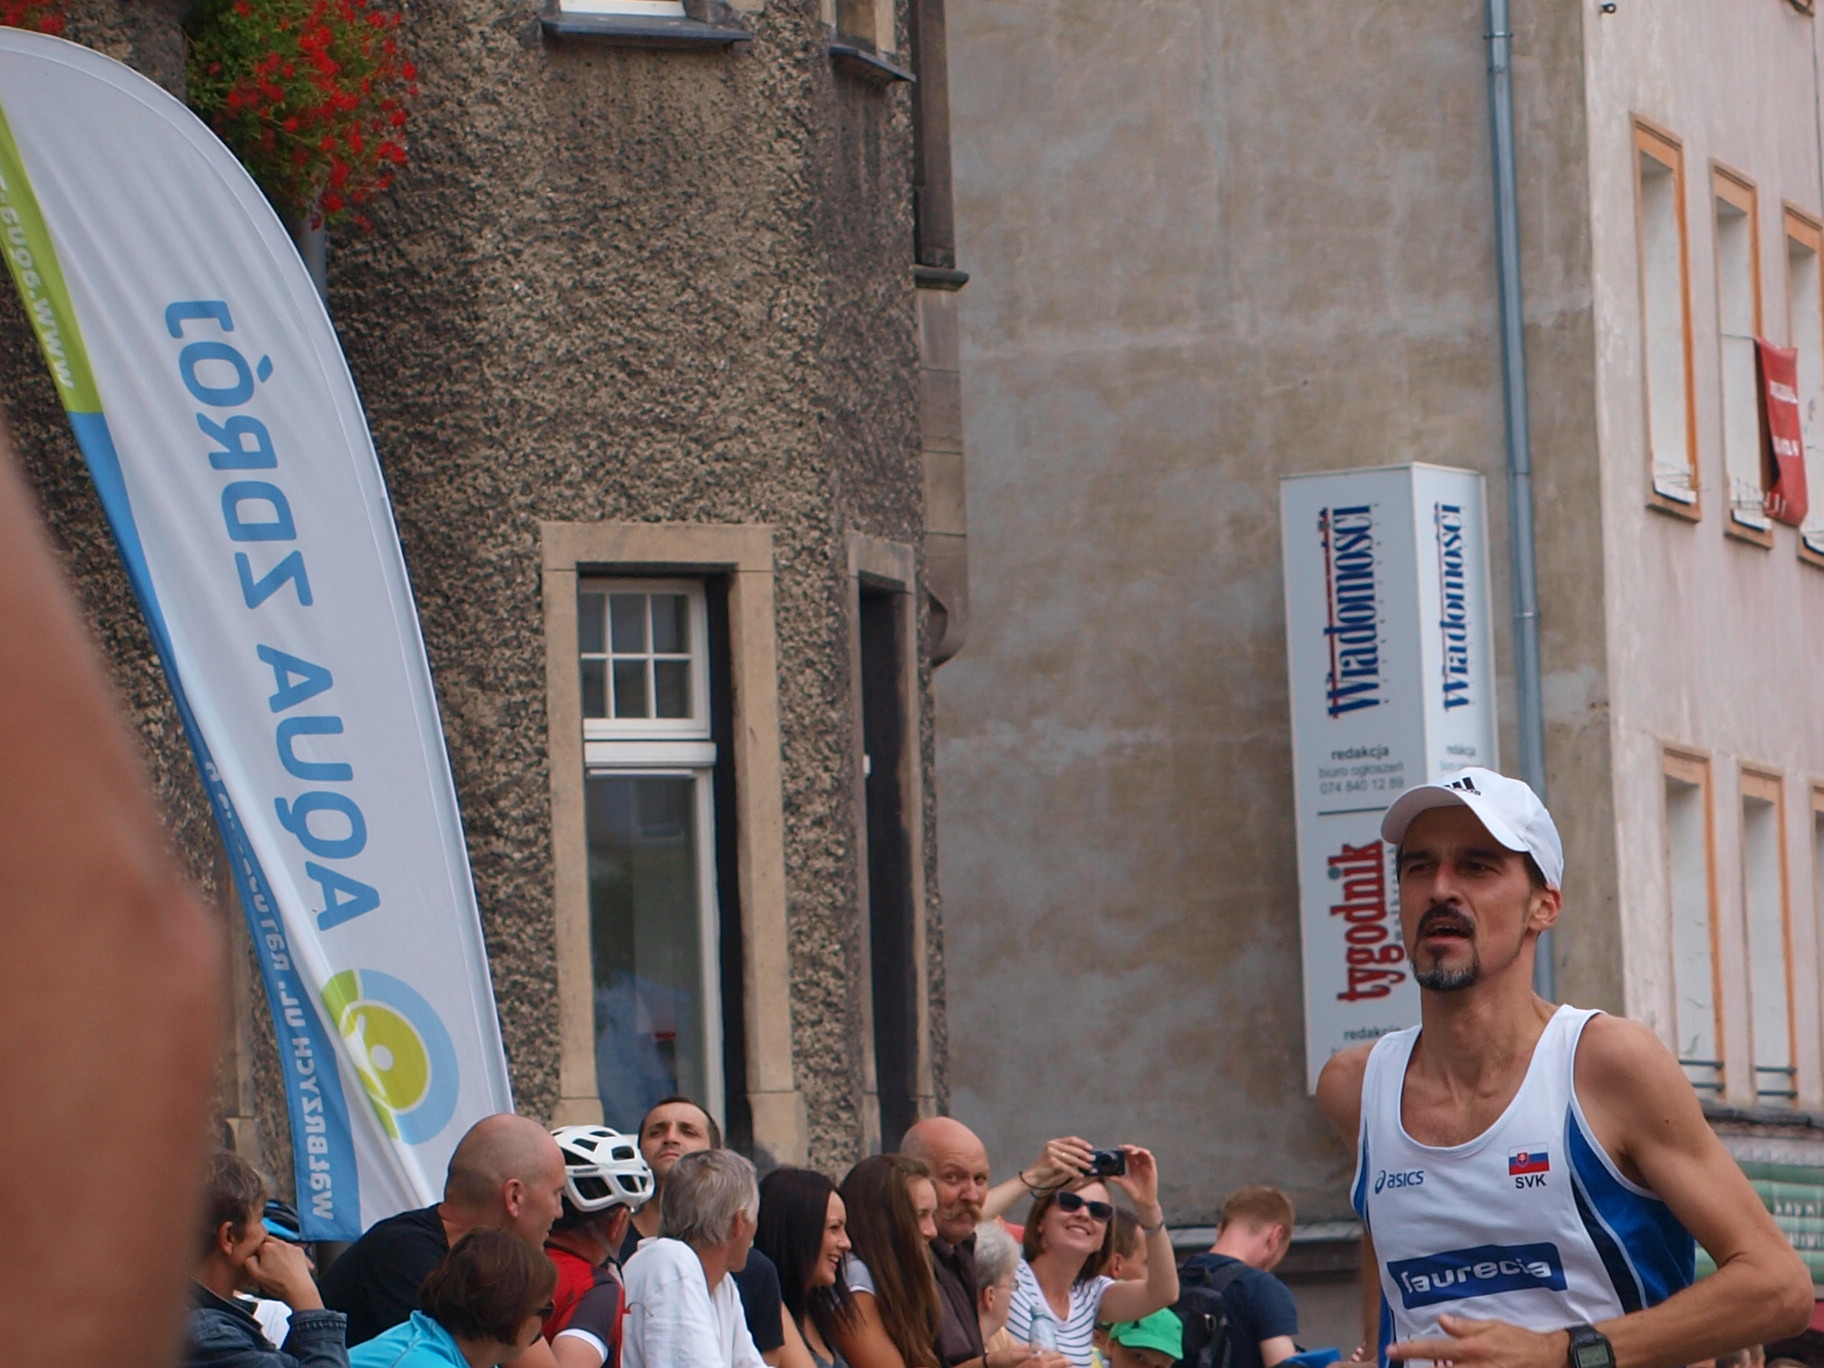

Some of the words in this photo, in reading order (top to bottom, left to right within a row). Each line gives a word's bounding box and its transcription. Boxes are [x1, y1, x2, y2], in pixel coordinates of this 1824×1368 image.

[1331, 744, 1389, 760] redakcja
[1318, 767, 1349, 778] biuro
[1328, 839, 1405, 1002] tygodnik
[1515, 1174, 1547, 1189] SVK
[1401, 1258, 1552, 1293] faurecia
